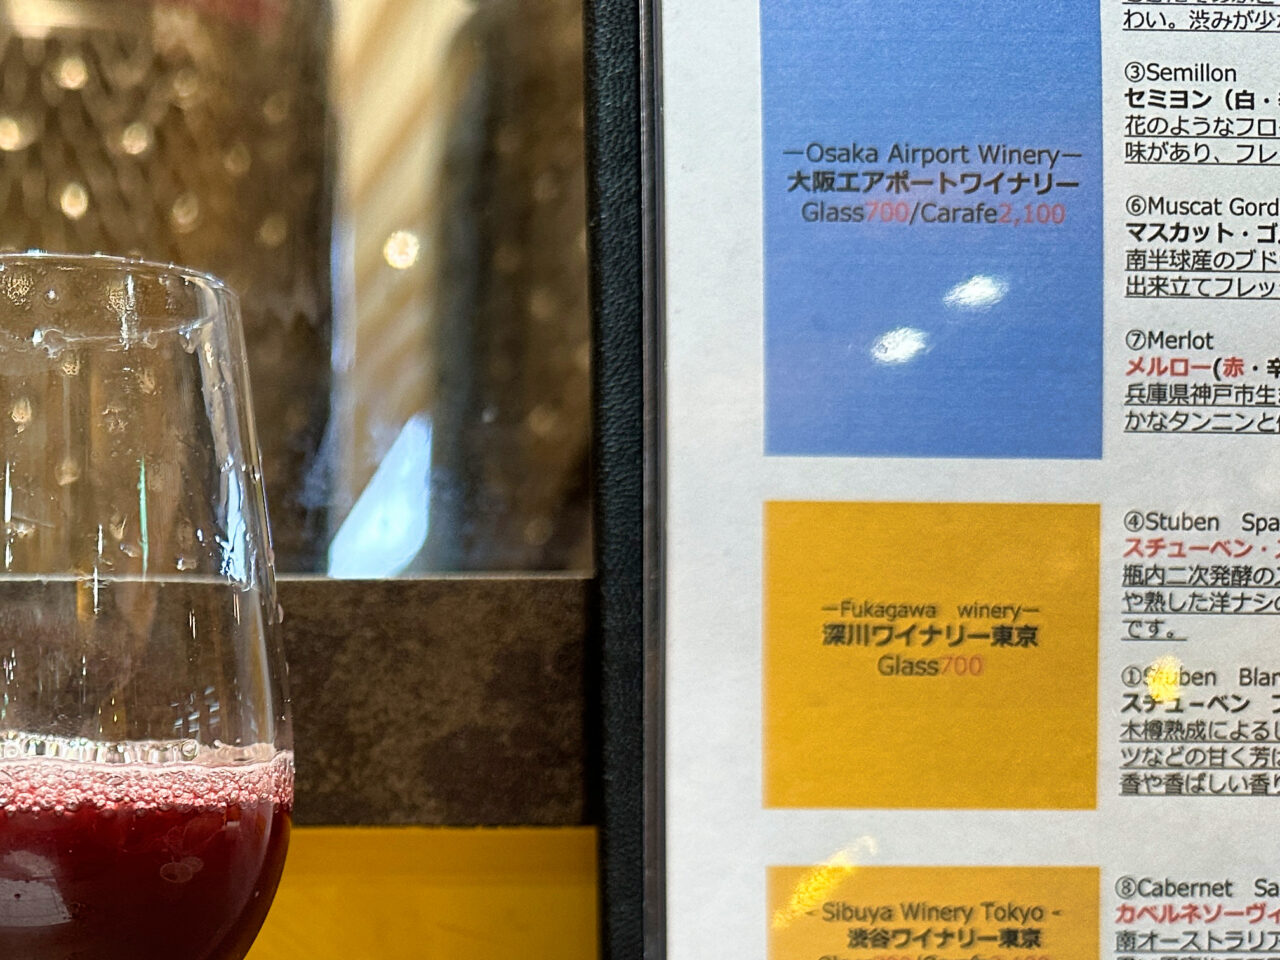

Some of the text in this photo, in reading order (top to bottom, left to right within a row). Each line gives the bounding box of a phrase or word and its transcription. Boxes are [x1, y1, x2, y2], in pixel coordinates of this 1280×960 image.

[1123, 9, 1280, 30] わい。渋みが少
[1124, 87, 1280, 110] セミヨン（白・
[1124, 114, 1280, 136] 花のようなフロ
[887, 143, 970, 168] Airport
[786, 170, 1080, 195] 大阪エアポートワイナリー
[1229, 197, 1280, 216] Gord
[1125, 222, 1280, 243] マスカット・ゴ
[1125, 249, 1280, 270] 南半球産のブド
[1125, 275, 1280, 297] 出来立てフレッ
[1125, 382, 1280, 405] 兵庫県神戸市生
[1125, 410, 1280, 432] かなタンニンと
[1241, 512, 1280, 535] Spa
[1123, 537, 1280, 558] スチューベン・
[822, 624, 1039, 648] 深川ワイナリー東京
[1122, 619, 1174, 639] です。
[877, 653, 984, 677] Glass700
[1254, 878, 1280, 898] Sa
[822, 901, 894, 925] Sibuya
[900, 902, 974, 925] Winery
[980, 901, 1045, 925] Tokyo
[847, 927, 1041, 950] 渋谷ワイナリー東京
